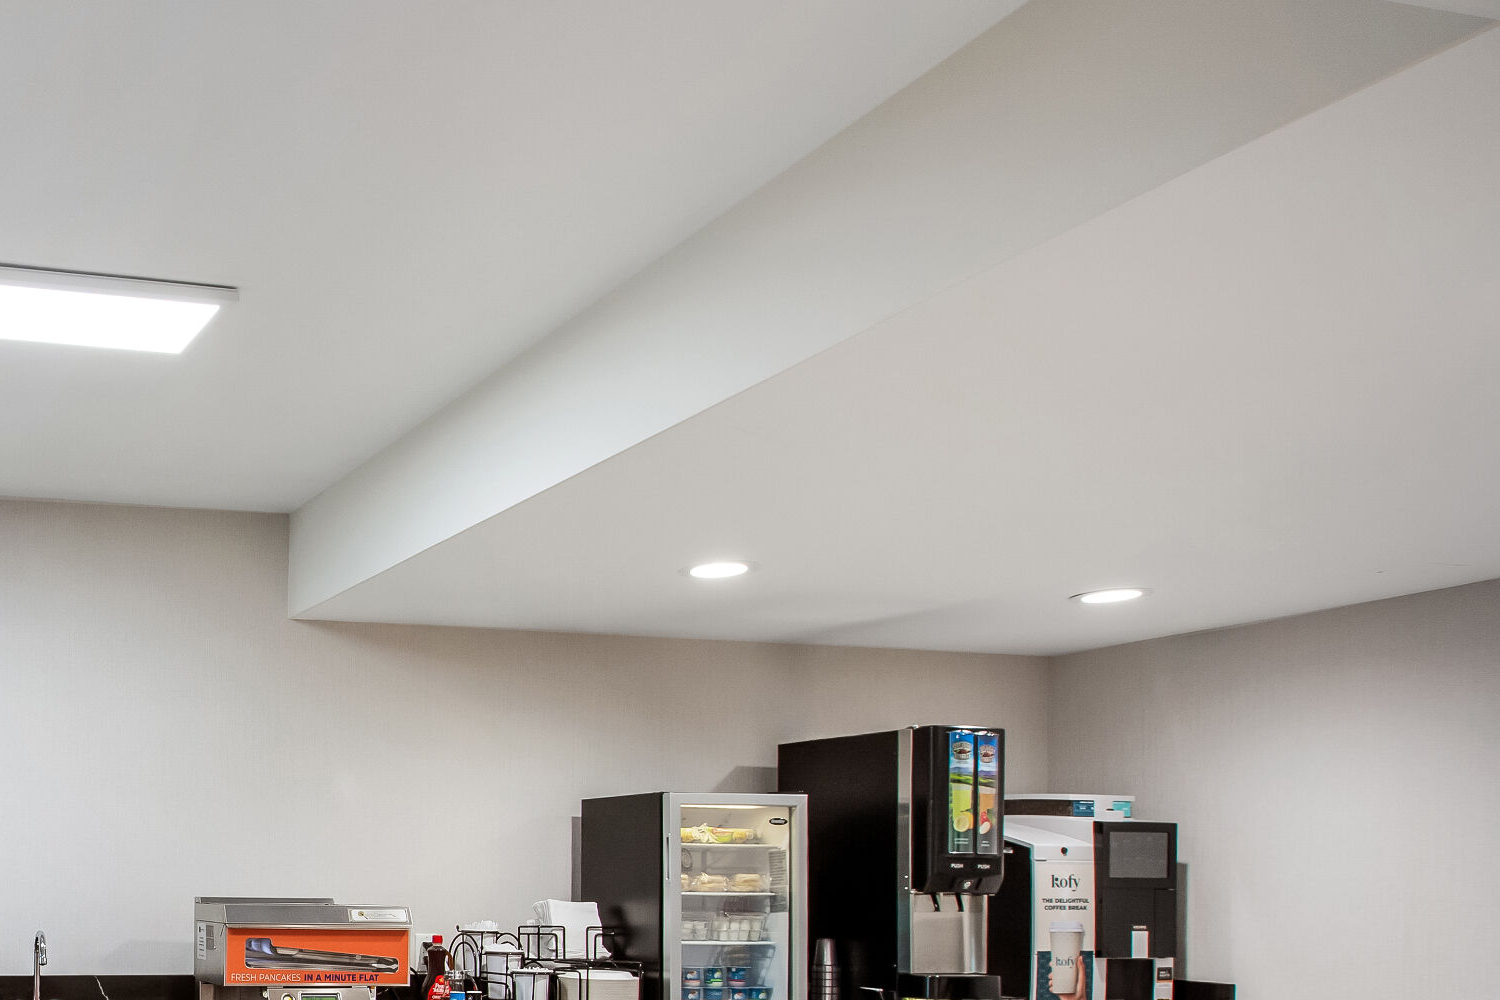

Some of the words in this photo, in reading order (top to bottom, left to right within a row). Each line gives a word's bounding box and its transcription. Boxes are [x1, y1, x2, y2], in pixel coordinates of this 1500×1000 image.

[1051, 874, 1081, 892] kofy
[230, 973, 257, 982] FRESH
[259, 973, 301, 982] PANCAKES
[304, 973, 314, 982] IN
[315, 973, 322, 982] A
[324, 973, 357, 982] MINUTE
[358, 973, 379, 982] FLAT
